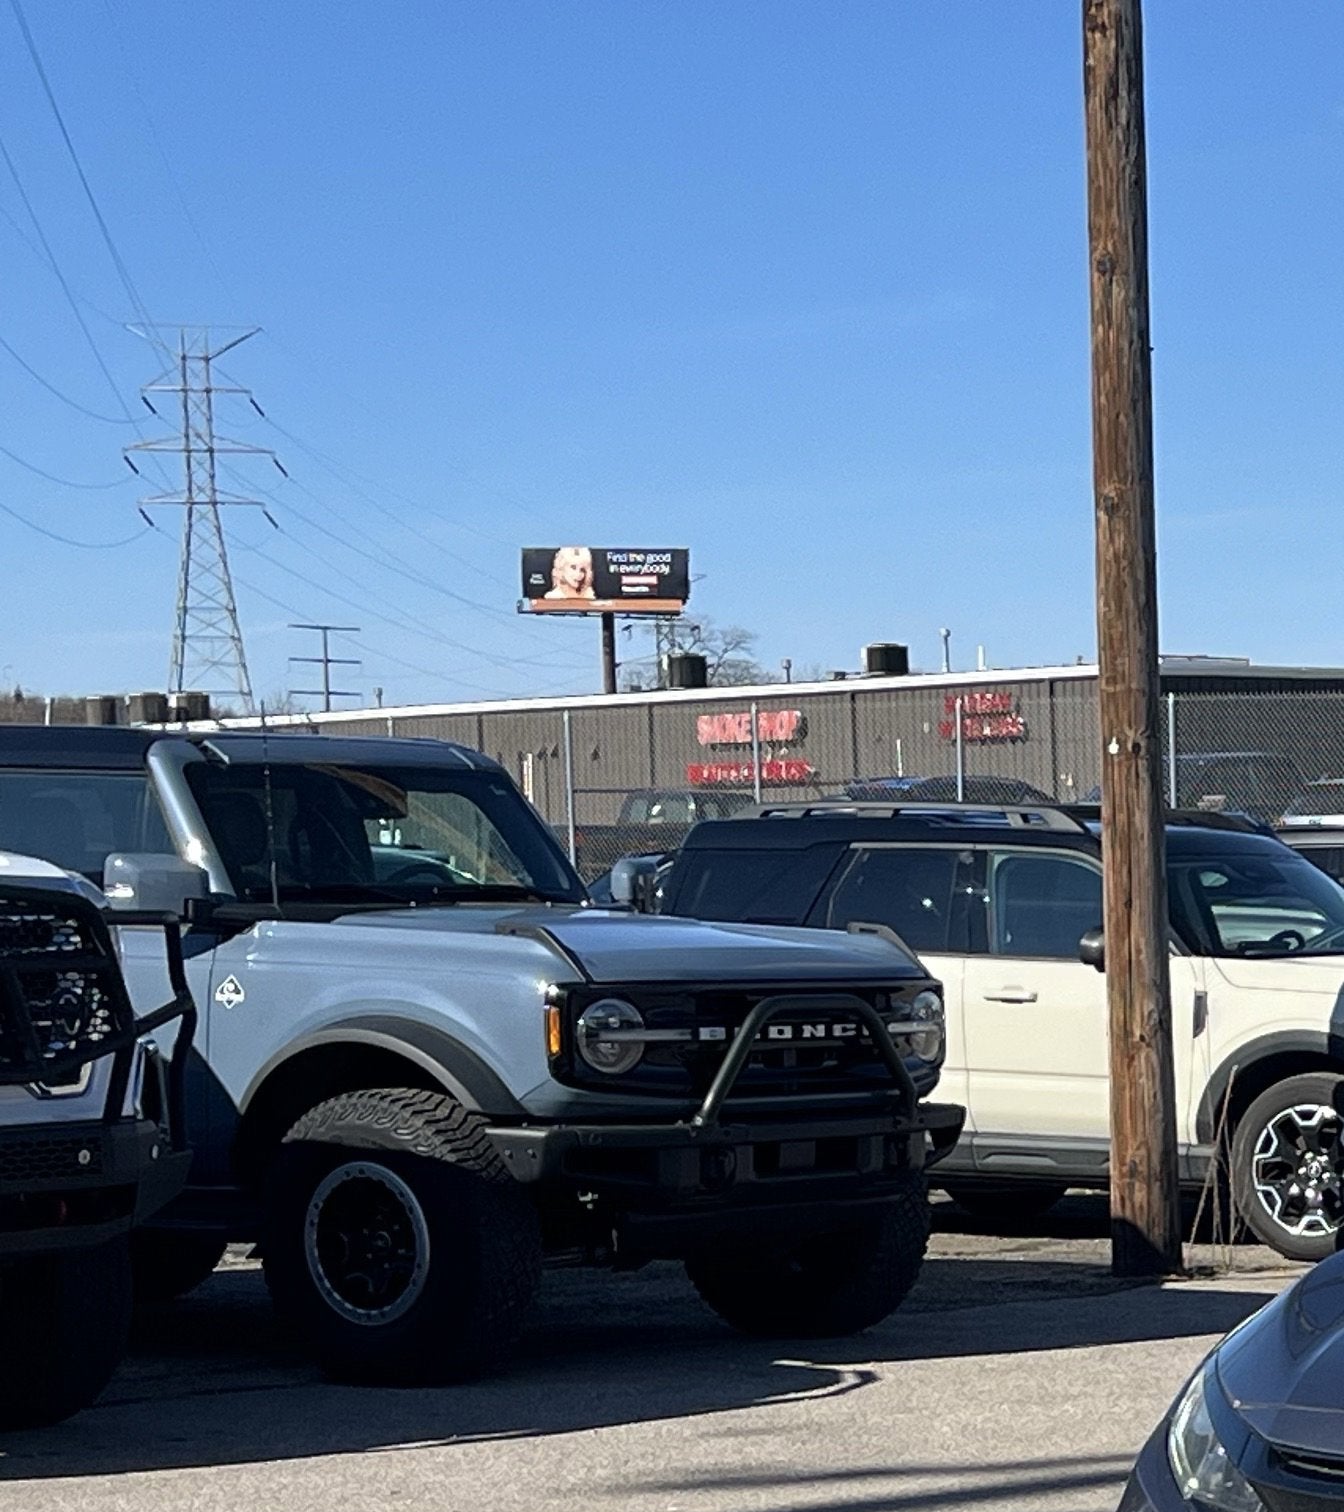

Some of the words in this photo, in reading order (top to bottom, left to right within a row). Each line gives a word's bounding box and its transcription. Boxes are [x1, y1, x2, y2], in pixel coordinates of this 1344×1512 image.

[629, 553, 645, 562] the
[646, 553, 671, 564] good
[699, 1024, 870, 1040] BONC
